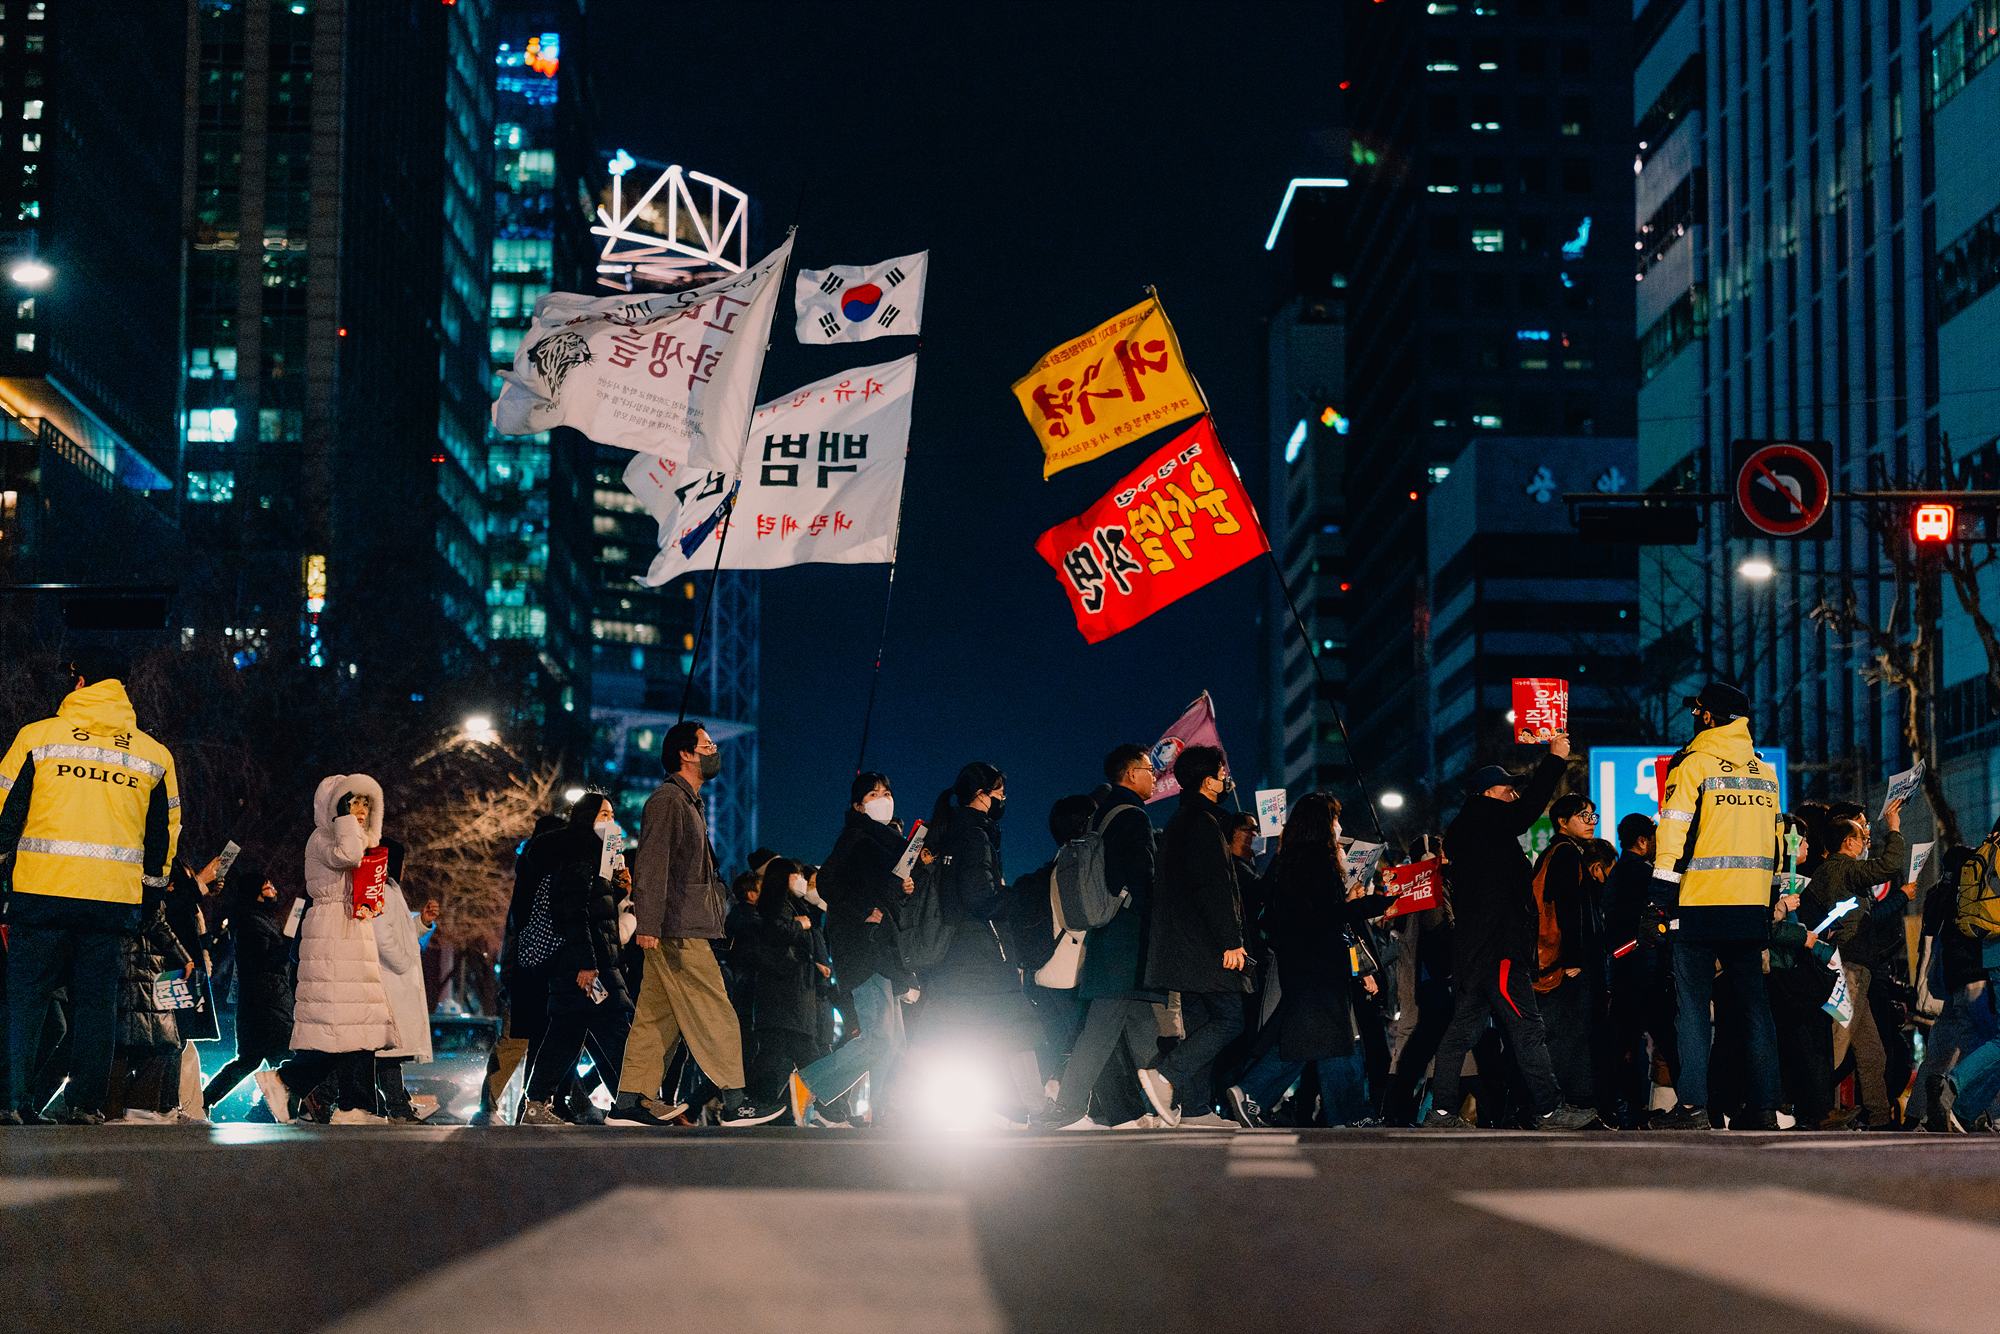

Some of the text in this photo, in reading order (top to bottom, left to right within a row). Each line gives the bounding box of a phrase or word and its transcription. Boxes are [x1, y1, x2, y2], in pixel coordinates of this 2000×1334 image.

[1525, 709, 1558, 728] 즉각
[56, 764, 139, 788] POLICE
[1715, 794, 1772, 807] POLICE
